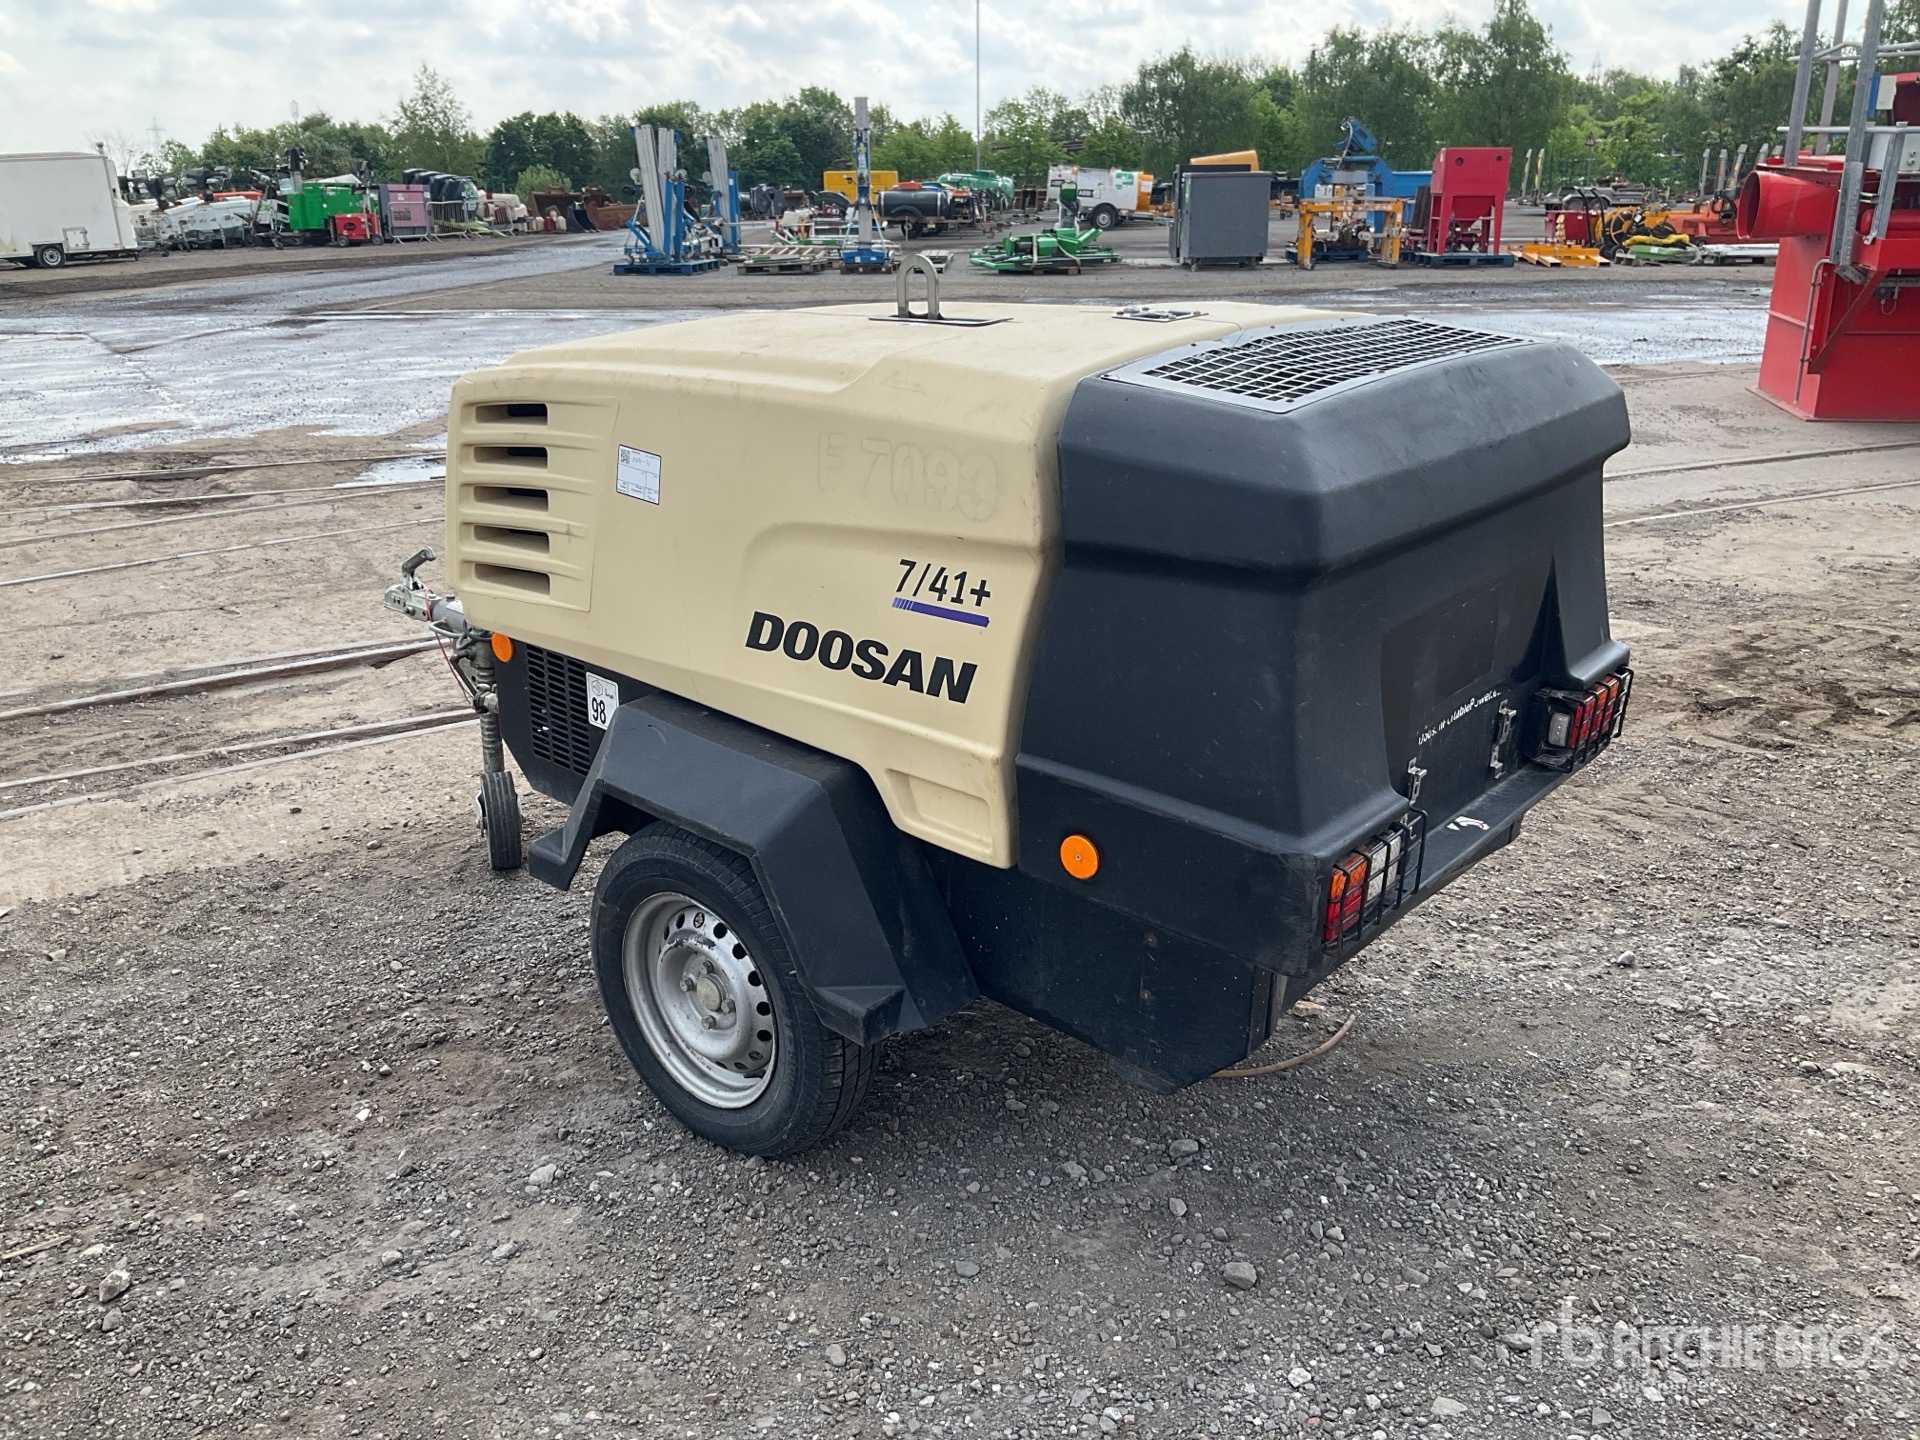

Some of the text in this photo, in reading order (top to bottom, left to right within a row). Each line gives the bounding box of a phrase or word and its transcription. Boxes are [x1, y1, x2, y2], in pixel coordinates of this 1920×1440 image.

[896, 559, 991, 607] 7/41+
[745, 611, 978, 704] DOOSAN
[591, 696, 607, 725] 98
